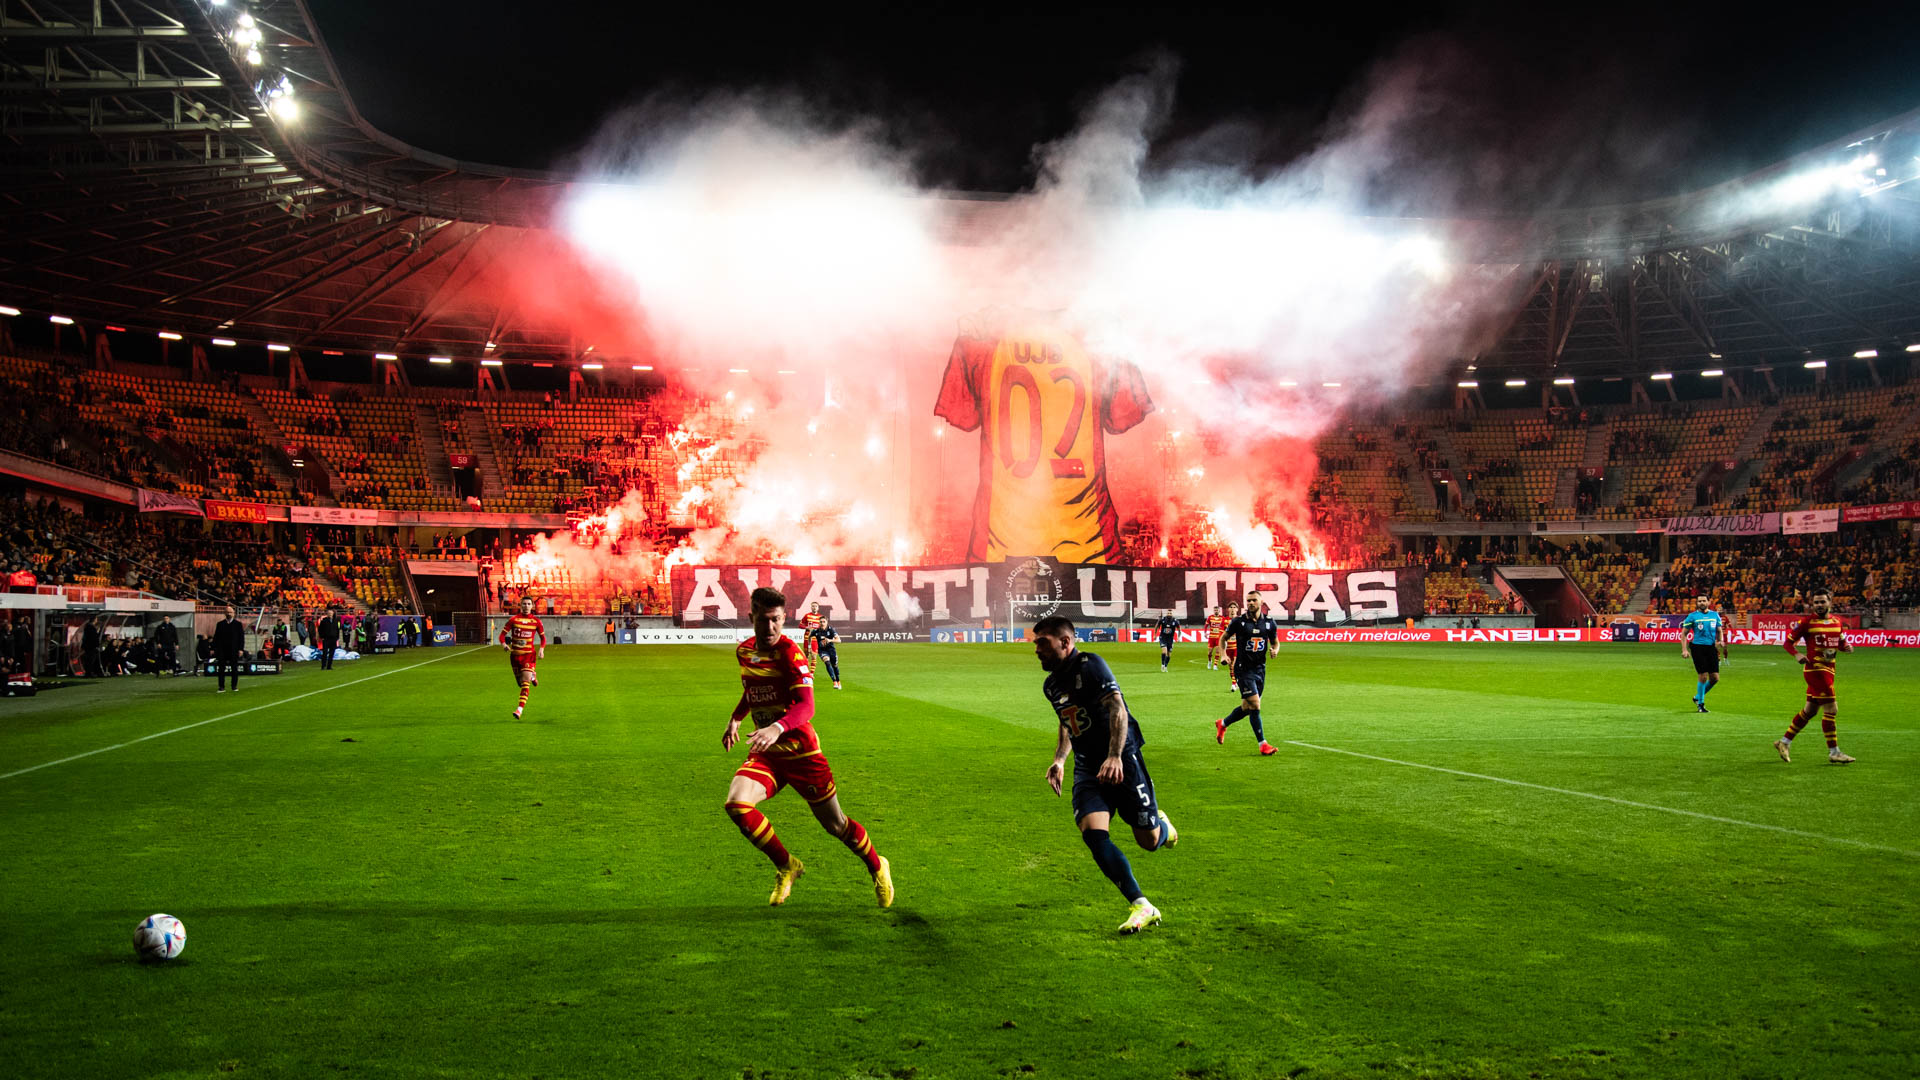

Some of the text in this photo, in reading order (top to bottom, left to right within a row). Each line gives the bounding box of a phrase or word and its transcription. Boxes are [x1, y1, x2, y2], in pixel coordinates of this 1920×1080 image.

[1014, 342, 1063, 364] UJB
[999, 365, 1086, 478] 02
[457, 456, 468, 467] 59
[1584, 468, 1596, 477] 57
[683, 567, 990, 621] AVANTI
[1076, 567, 1399, 624] ULTRAS
[855, 632, 914, 641] PAPA PASTA
[1286, 630, 1431, 643] Sztachety metalowe
[1445, 629, 1581, 642] HANBUD
[1245, 637, 1266, 652] STS
[1136, 783, 1151, 807] 5
